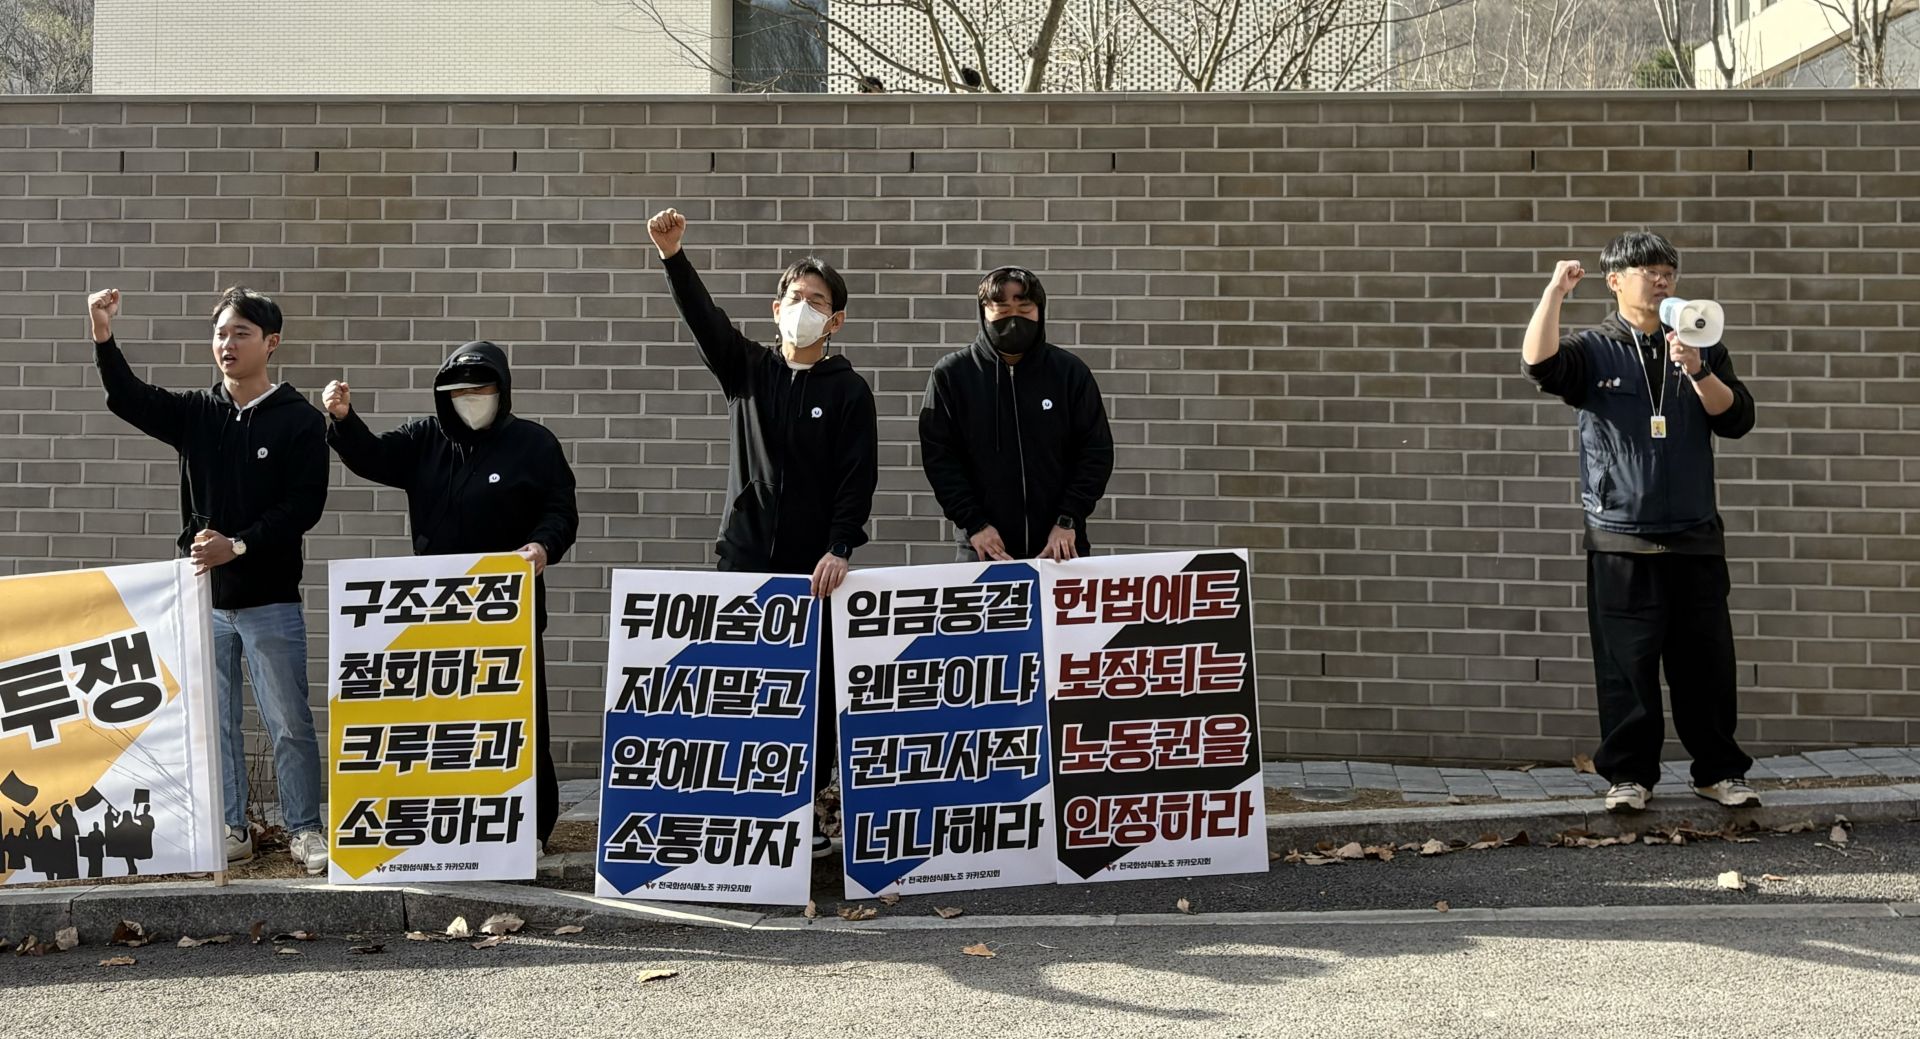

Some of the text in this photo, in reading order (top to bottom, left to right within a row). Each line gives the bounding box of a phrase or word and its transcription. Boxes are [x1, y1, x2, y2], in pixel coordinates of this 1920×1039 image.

[341, 575, 522, 627] 구조조정
[621, 594, 810, 644] 뒤에숨어
[847, 581, 1030, 638] 임금동결
[1054, 573, 1236, 624] 헌법에도
[0, 631, 163, 743] 투쟁
[339, 649, 521, 699] 철회하고
[612, 667, 805, 715] 지시말고
[847, 654, 1039, 713] 웬말이냐
[1057, 647, 1240, 696] 보장되는
[340, 722, 524, 772] 크루들과
[612, 739, 804, 793] 앞에나와
[850, 728, 1039, 787] 권고사직
[1064, 718, 1245, 770] 노동권을
[339, 797, 524, 846] 소통하라
[608, 814, 800, 868] 소통하자
[855, 803, 1044, 863] 너나해라
[1066, 792, 1253, 844] 인정하라
[444, 862, 479, 871] 카카오지회
[965, 869, 1001, 880] 카카오지회
[1176, 857, 1211, 867] 카카오지회
[716, 883, 752, 893] 카카오지회
